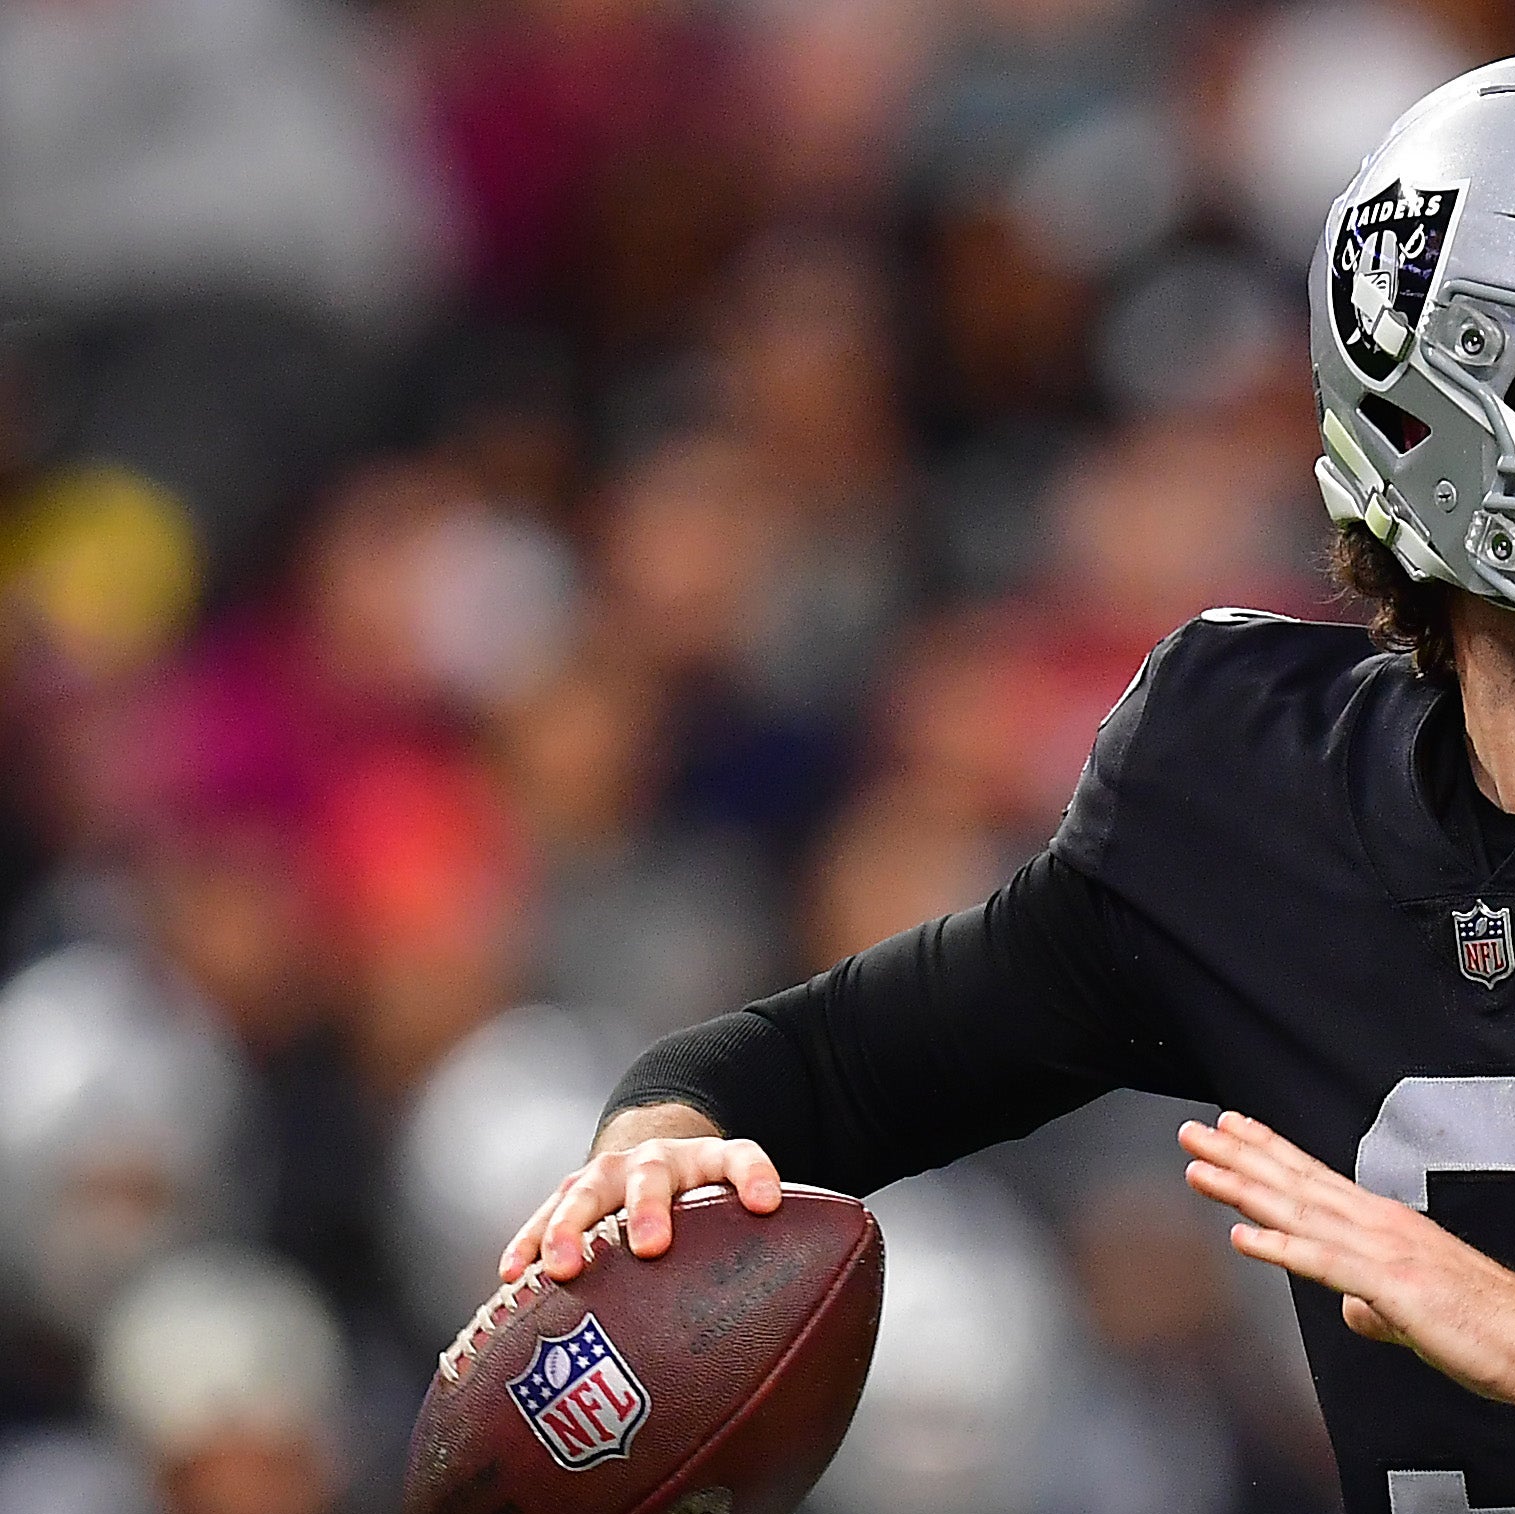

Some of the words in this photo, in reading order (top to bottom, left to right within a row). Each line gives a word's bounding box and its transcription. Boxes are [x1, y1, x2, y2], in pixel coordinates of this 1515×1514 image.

[1346, 194, 1443, 232] RAIDERS
[1464, 941, 1505, 975] NFL
[541, 1369, 637, 1458] NFL
